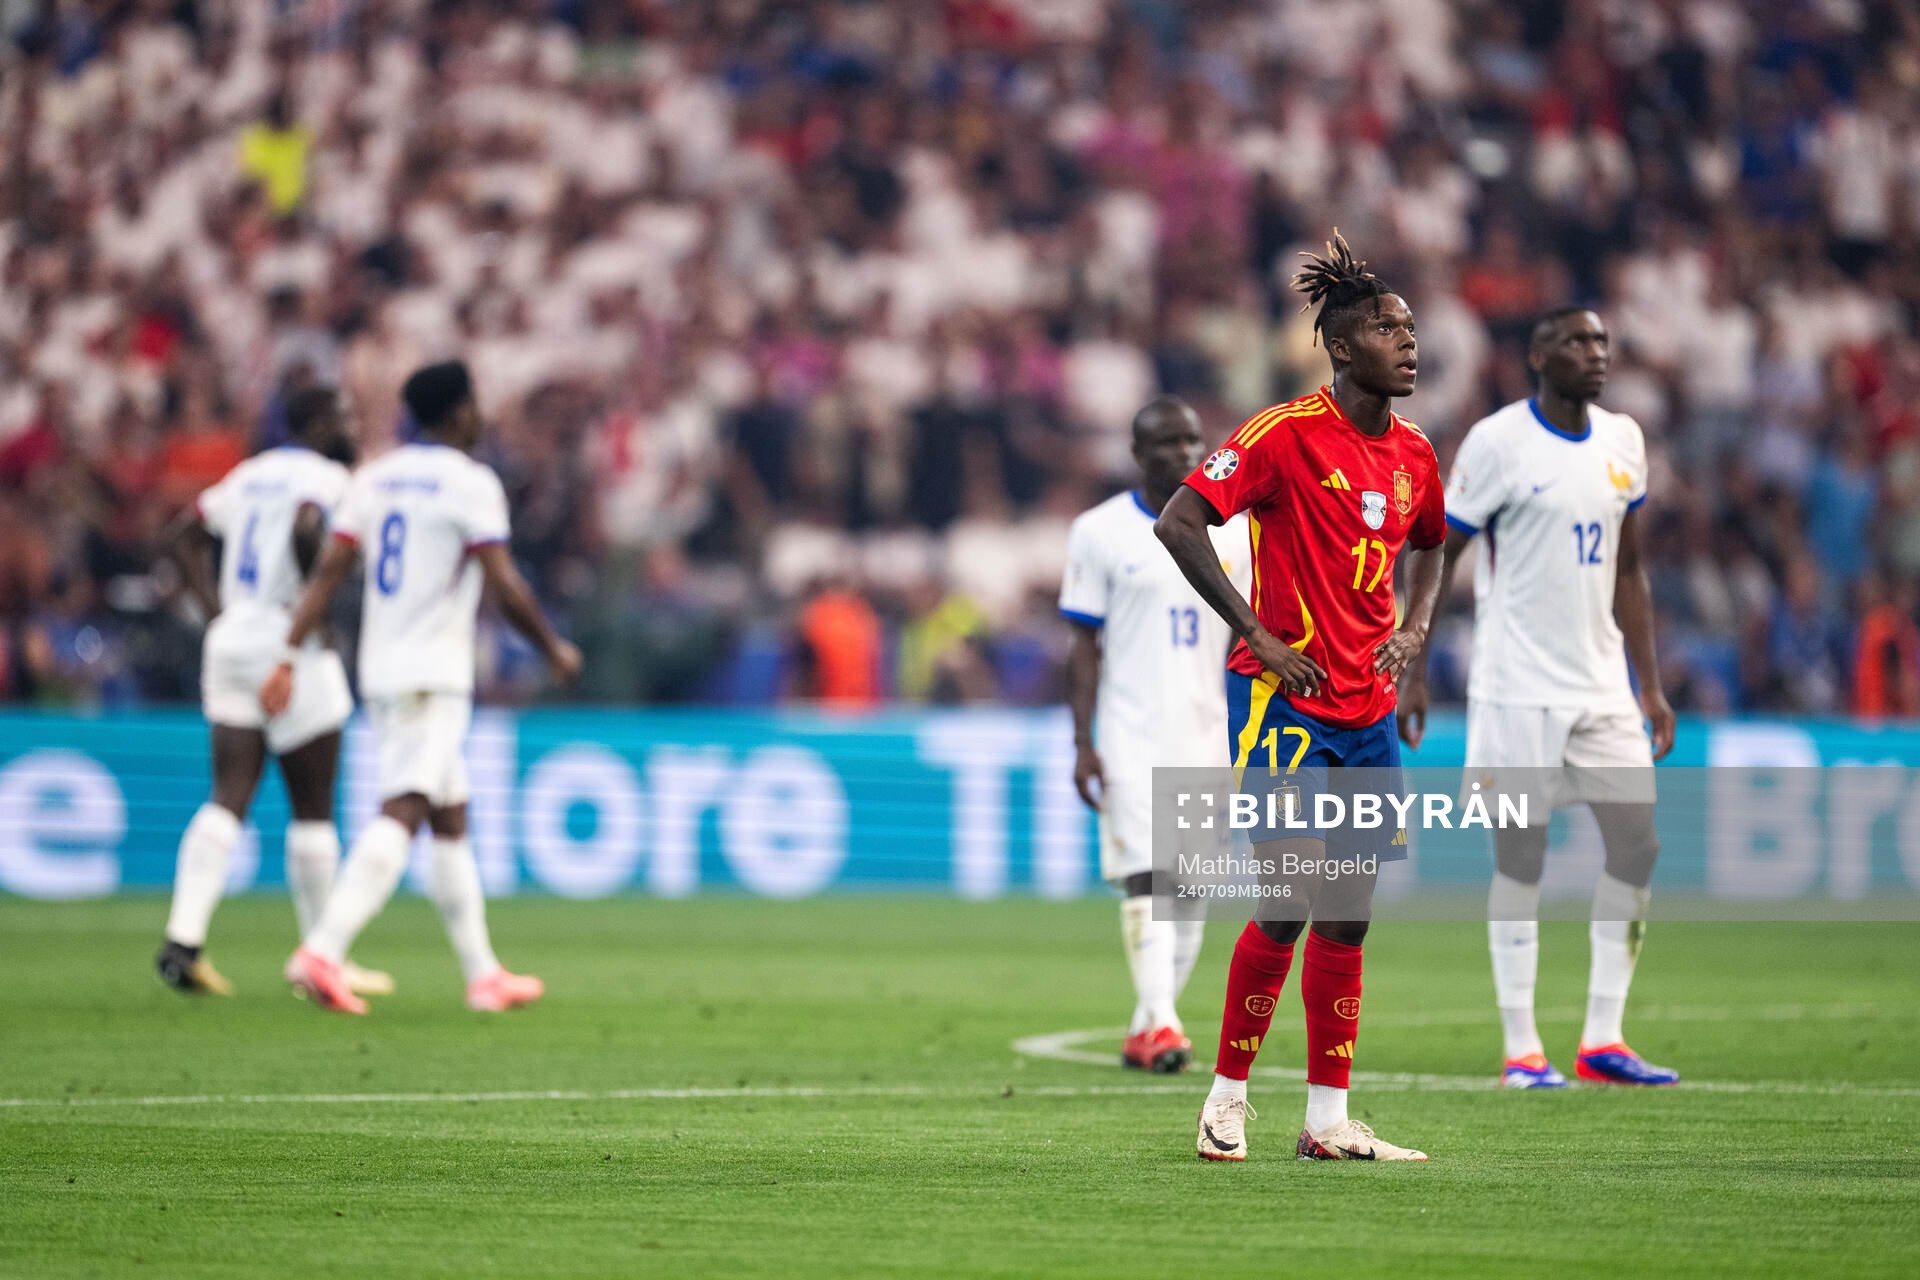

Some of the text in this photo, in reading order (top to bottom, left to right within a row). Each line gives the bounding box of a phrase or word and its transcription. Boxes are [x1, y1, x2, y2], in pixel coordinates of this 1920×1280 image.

[376, 510, 407, 596] 8
[1351, 537, 1387, 593] 17
[1573, 522, 1603, 565] 12
[1169, 607, 1200, 648] 13
[1261, 726, 1312, 777] 17
[1705, 722, 1920, 901] Br
